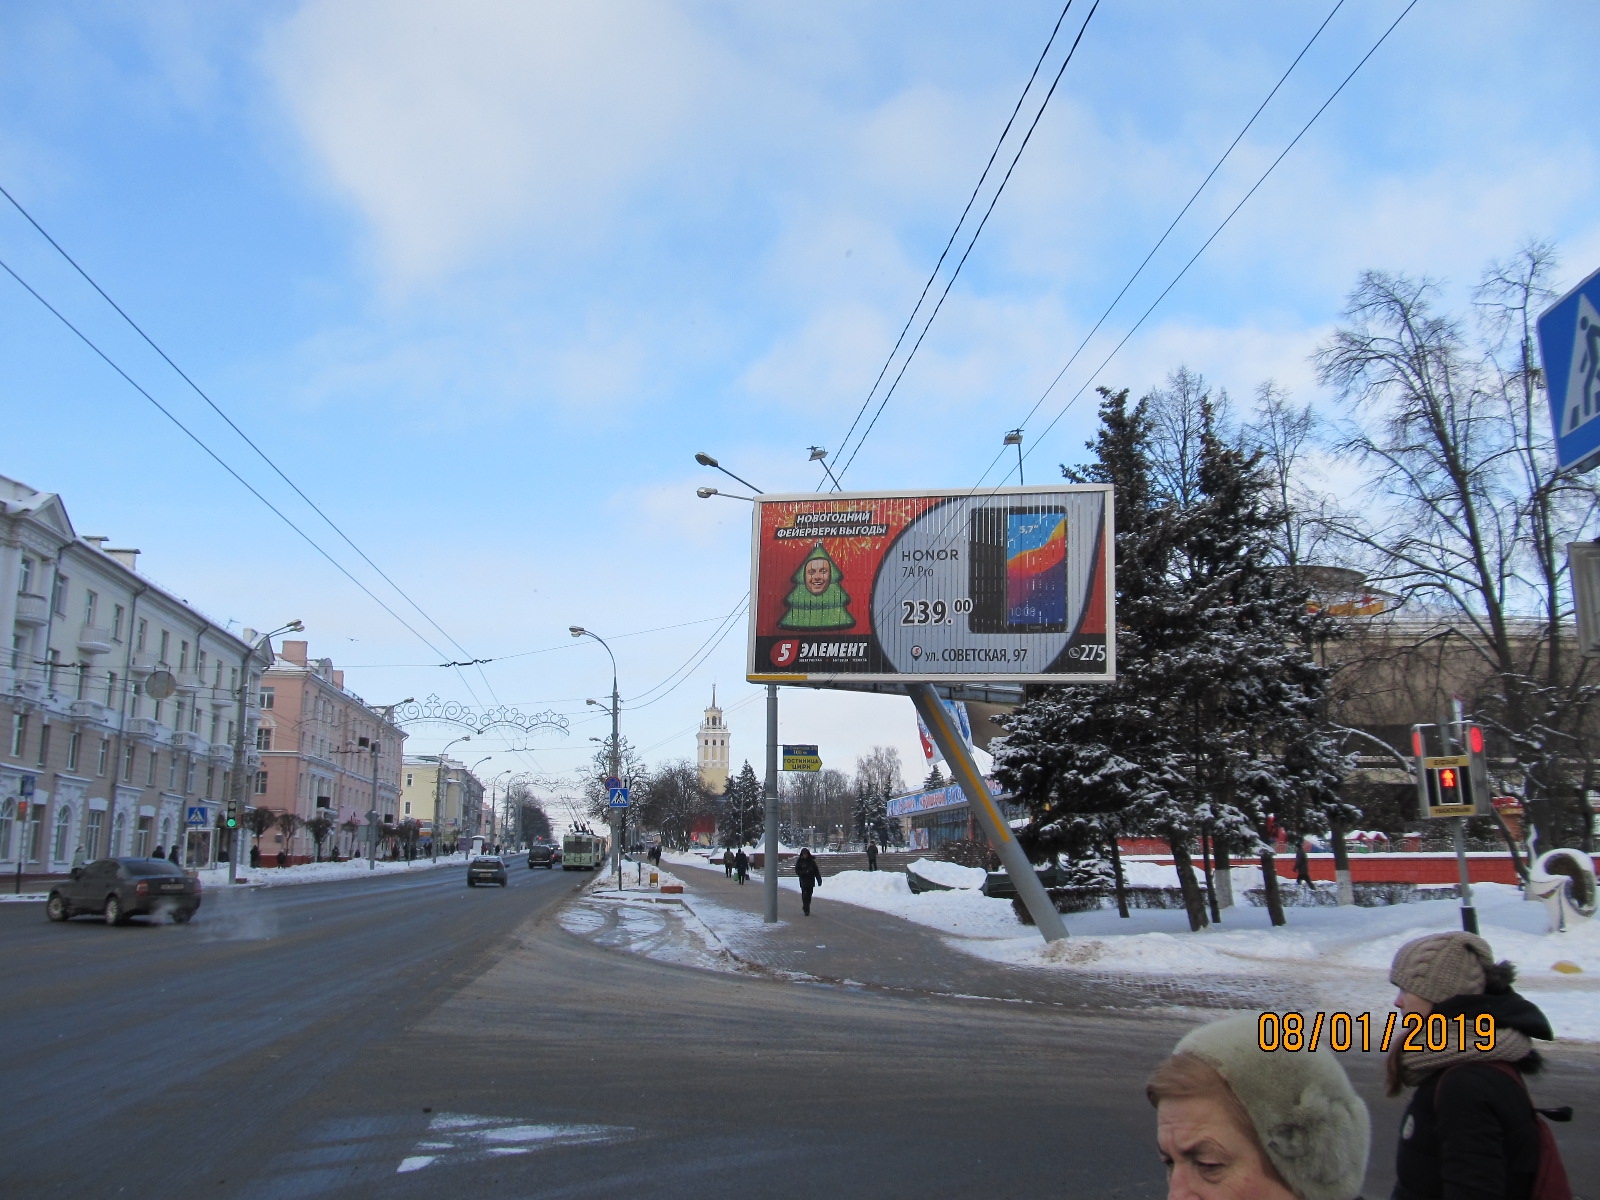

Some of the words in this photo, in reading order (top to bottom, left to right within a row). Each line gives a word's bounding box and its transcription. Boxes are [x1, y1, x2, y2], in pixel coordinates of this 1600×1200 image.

[796, 512, 870, 524] НОВОГОДНИЙ
[777, 527, 838, 538] ФЕЙЕРВЕРК
[839, 525, 887, 536] ВЫГОДЫ
[902, 549, 959, 562] HONOR
[902, 567, 914, 577] 7A
[918, 567, 934, 577] Pro
[777, 644, 792, 662] 5
[799, 642, 868, 658] ЭЛЕМЕНТ
[925, 651, 939, 662] ул.
[942, 648, 1010, 663] СОВЕТСКАЯ,
[1014, 648, 1027, 661] 97
[1080, 644, 1106, 661] 275
